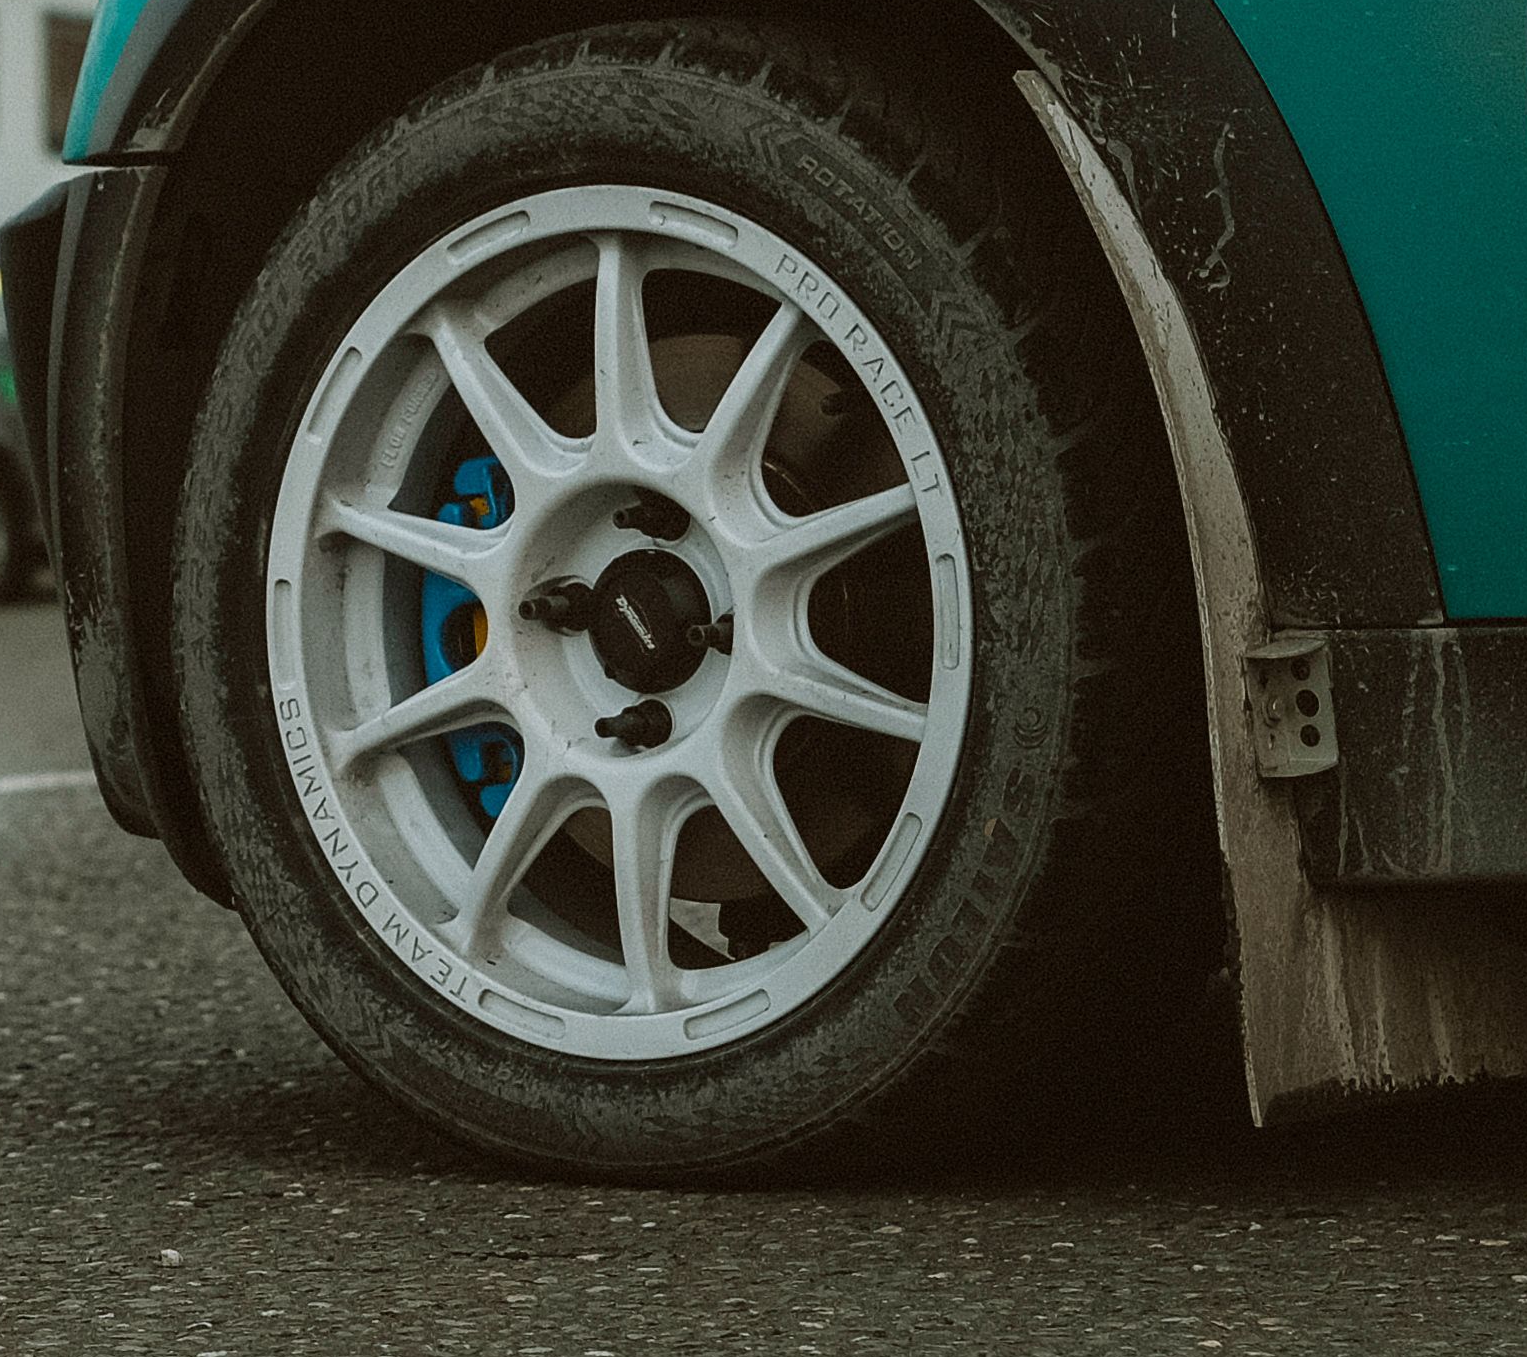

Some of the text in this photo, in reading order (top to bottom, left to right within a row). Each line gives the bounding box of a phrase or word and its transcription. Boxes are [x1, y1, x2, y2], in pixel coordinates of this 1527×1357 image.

[797, 152, 923, 271] ROTATION
[775, 253, 942, 495] PRO RACE LT
[279, 697, 468, 1003] TEAM DYNAMICS
